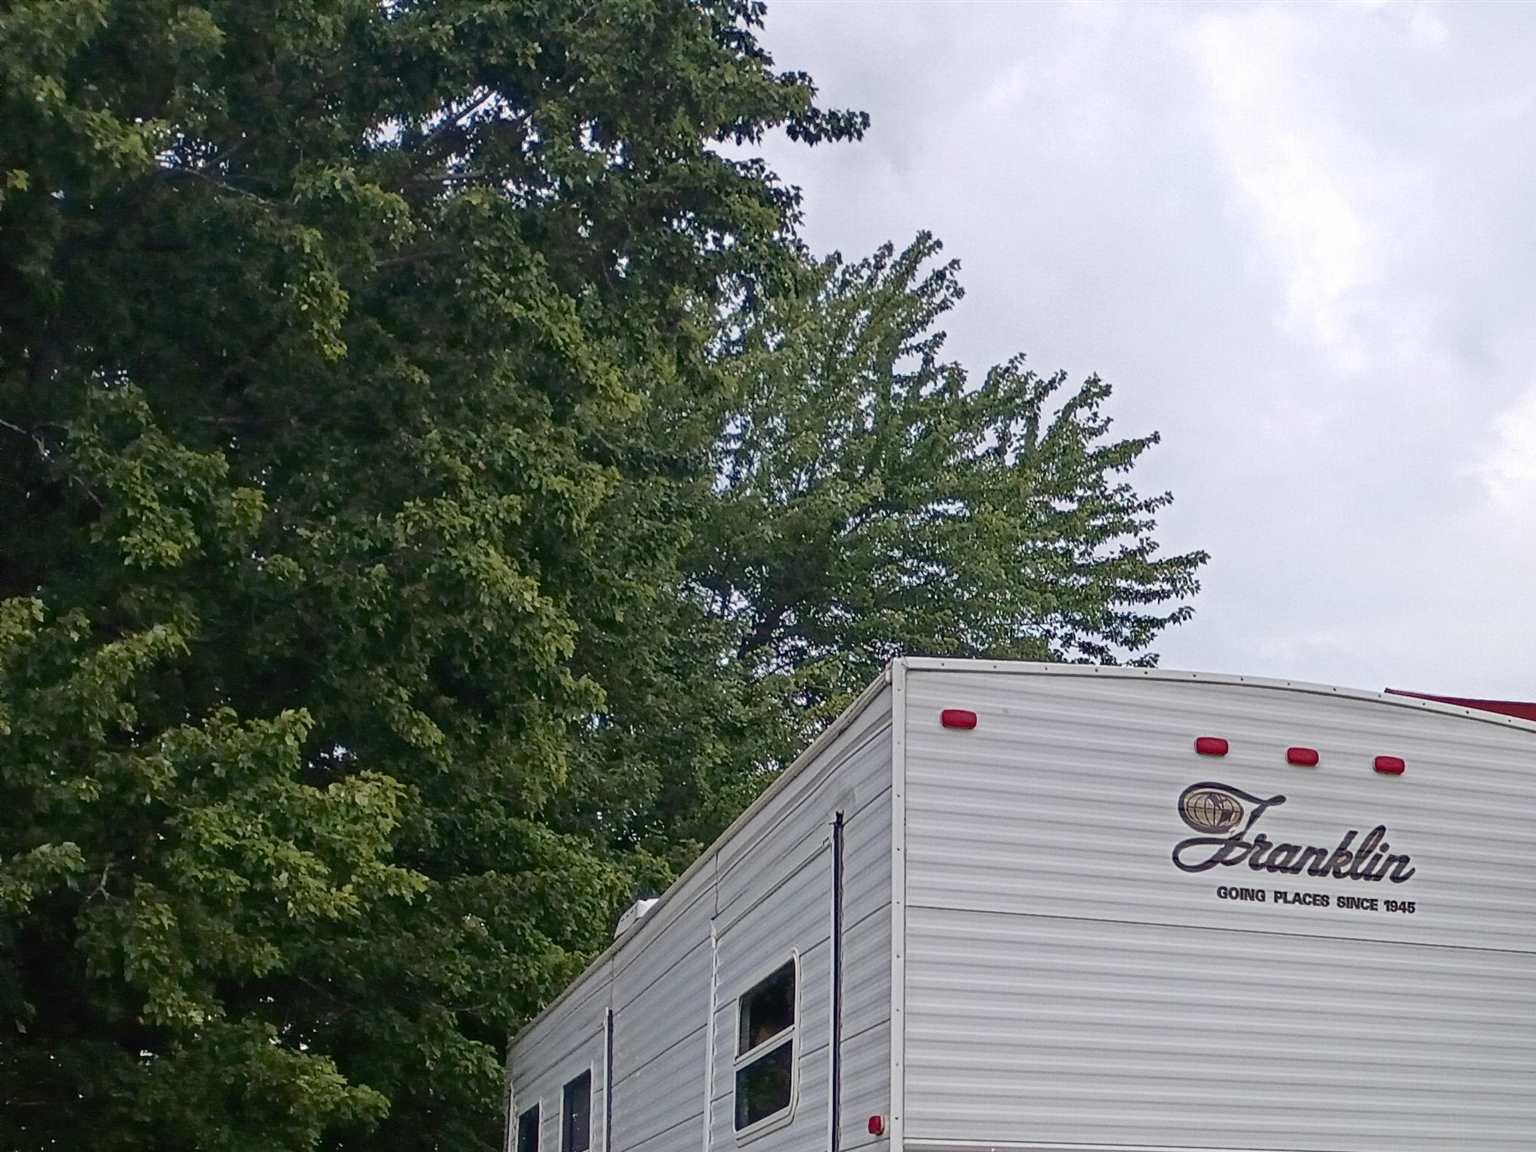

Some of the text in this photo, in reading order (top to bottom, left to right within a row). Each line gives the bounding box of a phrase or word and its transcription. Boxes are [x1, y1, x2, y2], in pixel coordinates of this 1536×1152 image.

[1172, 781, 1416, 884] Franklin
[1216, 886, 1416, 914] GOING PLACES SINCE 1945
